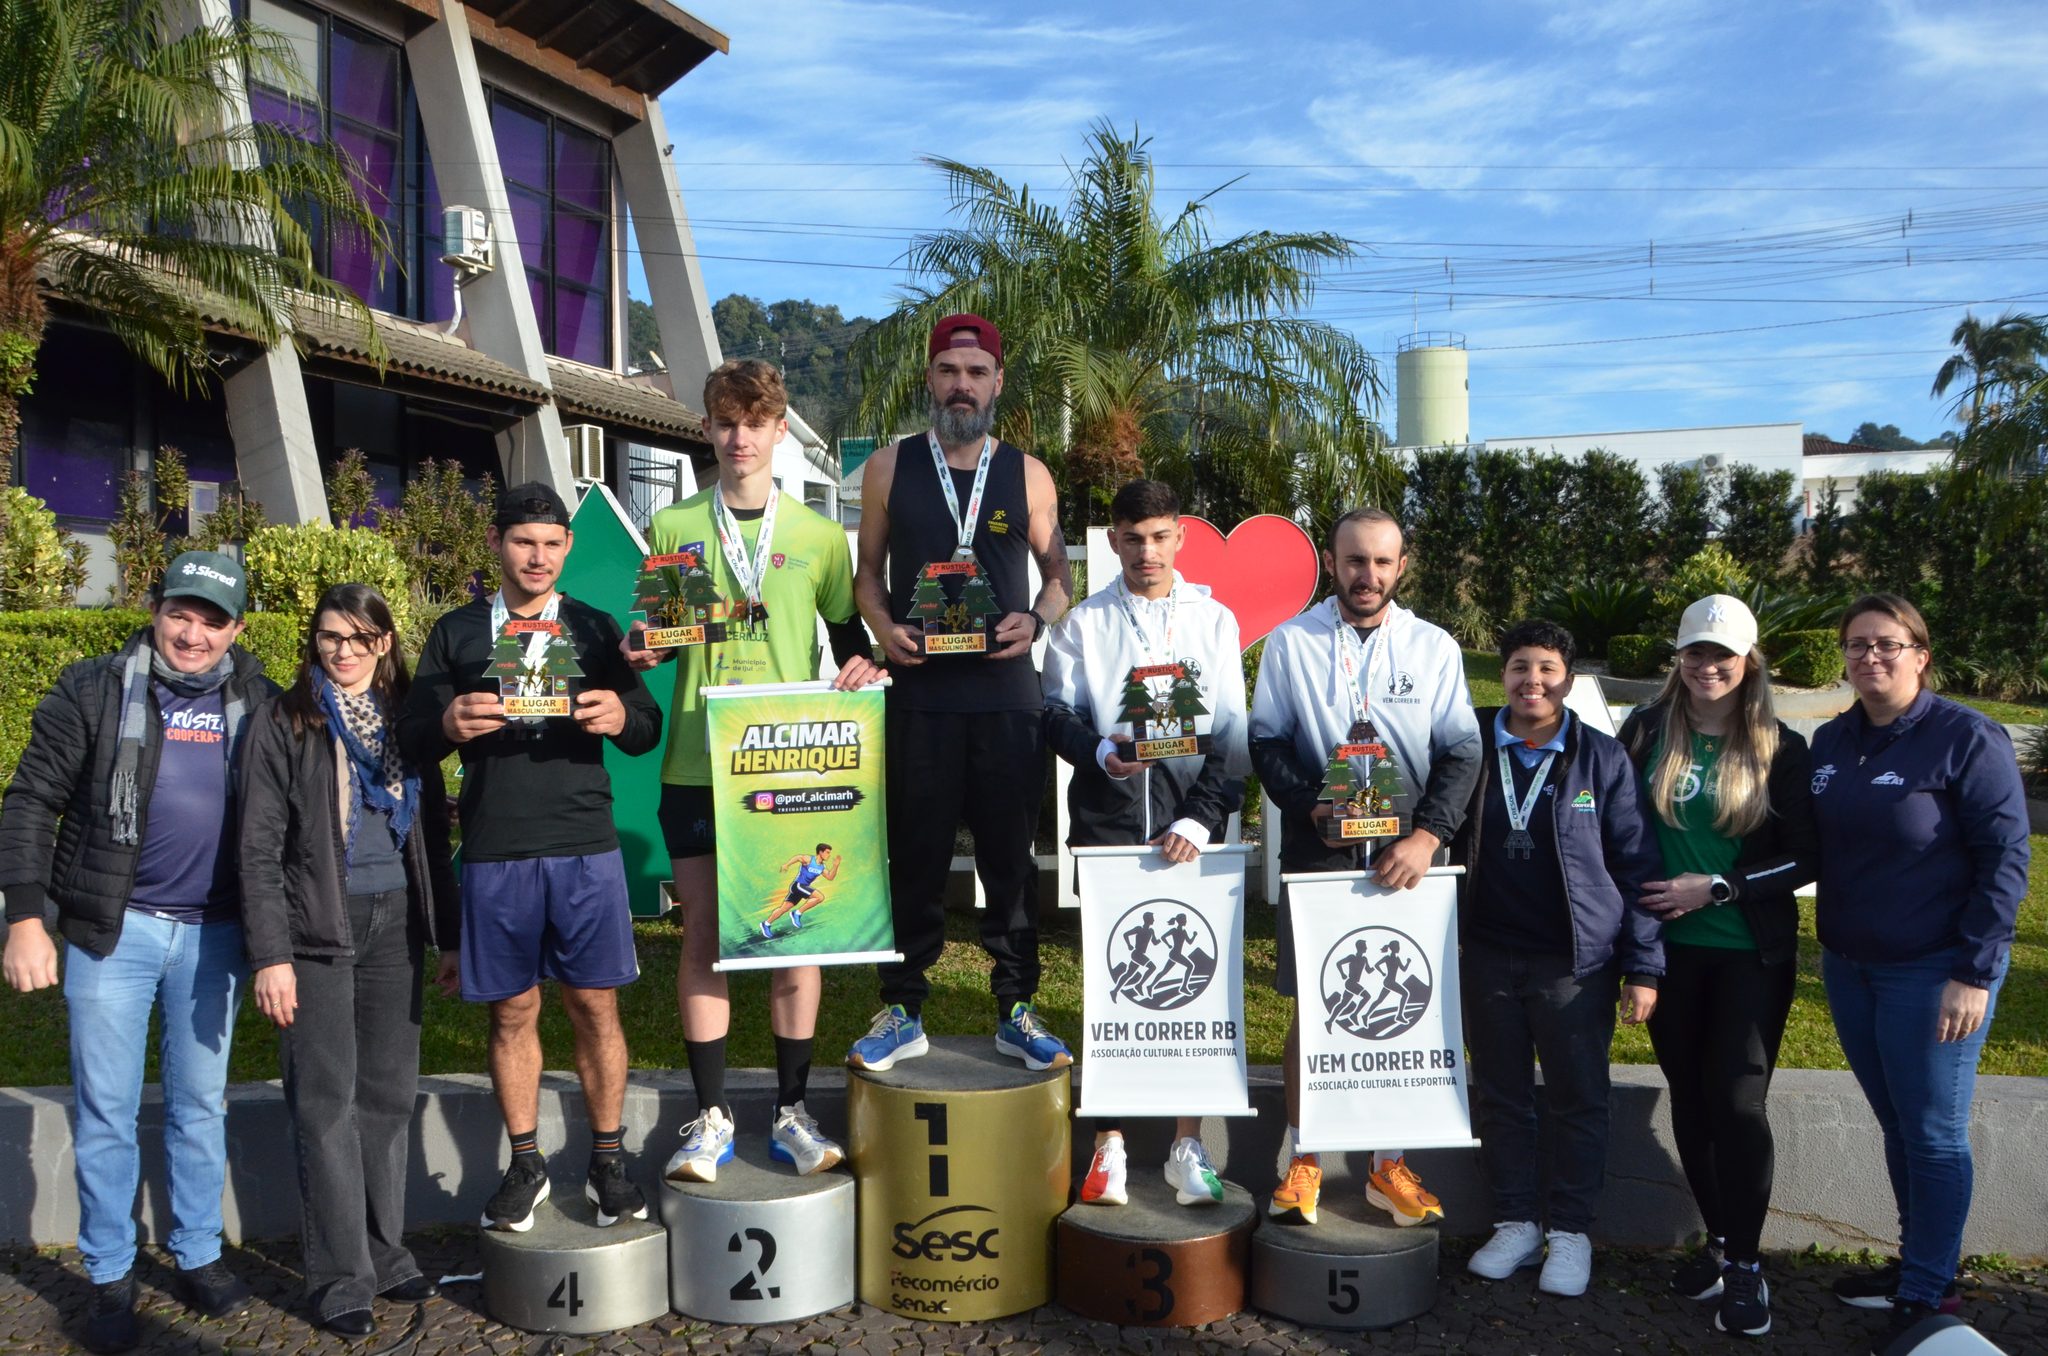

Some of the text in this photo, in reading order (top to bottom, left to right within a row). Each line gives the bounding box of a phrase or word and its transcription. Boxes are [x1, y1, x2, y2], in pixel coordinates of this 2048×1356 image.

[195, 565, 237, 588] Sicredi
[648, 639, 683, 647] MASCULINO
[661, 629, 692, 638] LUGAR
[942, 636, 973, 644] LUGAR
[167, 728, 223, 743] COOPERA+
[742, 722, 857, 750] ALCIMAR
[1153, 740, 1185, 750] LUGAR
[734, 746, 858, 772] HENRIQUE
[1139, 750, 1175, 758] MASCULINO
[775, 790, 853, 805] @prof_alcimarh
[1357, 821, 1387, 829] LUGAR
[1091, 1021, 1237, 1041] VEM CORRER RB
[1091, 1047, 1237, 1059] ASSOCIAÇÃO CULTURAL E ESPORTIVA
[1307, 1049, 1456, 1074] VEM CORRER RB
[1308, 1076, 1457, 1091] ASSOCIAÇÃO CULTURAL E ESPORTIVA
[914, 1103, 949, 1197] 1
[891, 1218, 1000, 1262] Sesc
[728, 1227, 781, 1301] 2
[547, 1272, 584, 1317] 4
[1125, 1249, 1176, 1322] 3
[1328, 1269, 1360, 1315] 5
[891, 1293, 948, 1314] Senac
